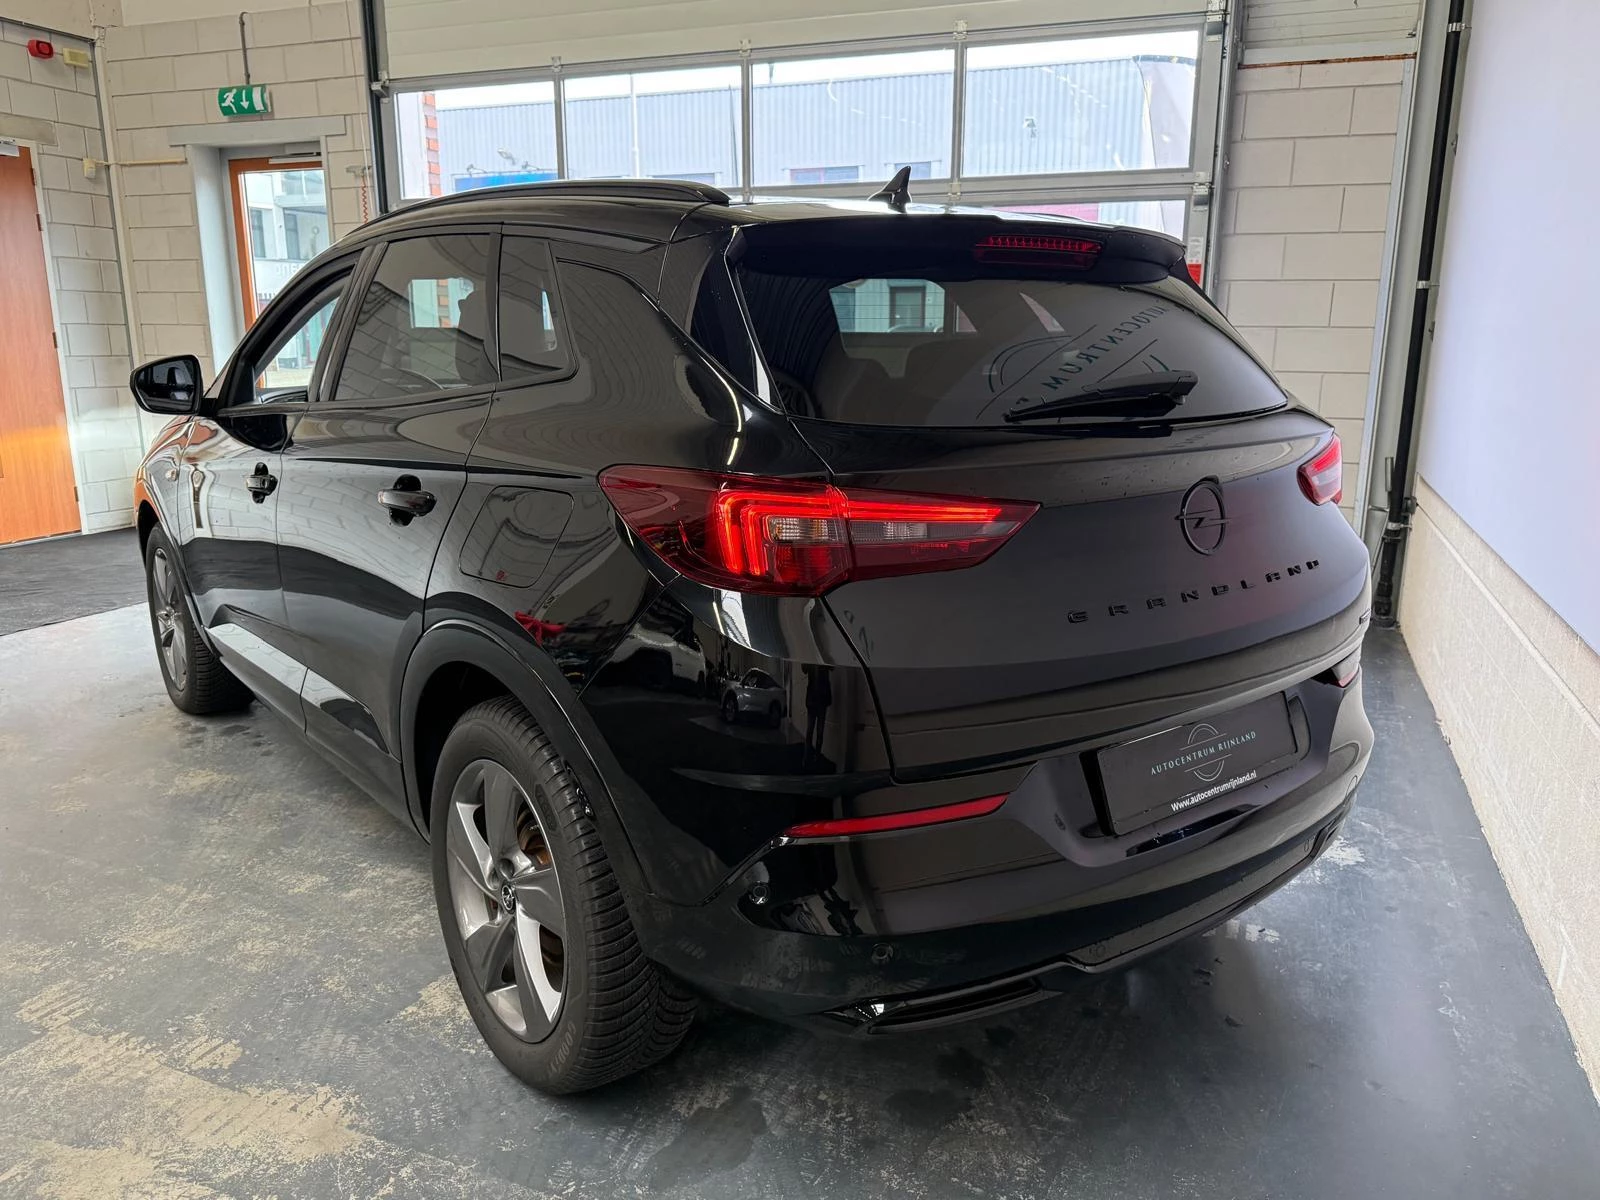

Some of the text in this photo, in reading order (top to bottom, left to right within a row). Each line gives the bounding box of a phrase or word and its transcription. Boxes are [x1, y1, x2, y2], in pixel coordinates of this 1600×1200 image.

[1067, 559, 1320, 624] GRANDLAND
[1150, 730, 1257, 776] AUTOCENTRUM RIJNLAND
